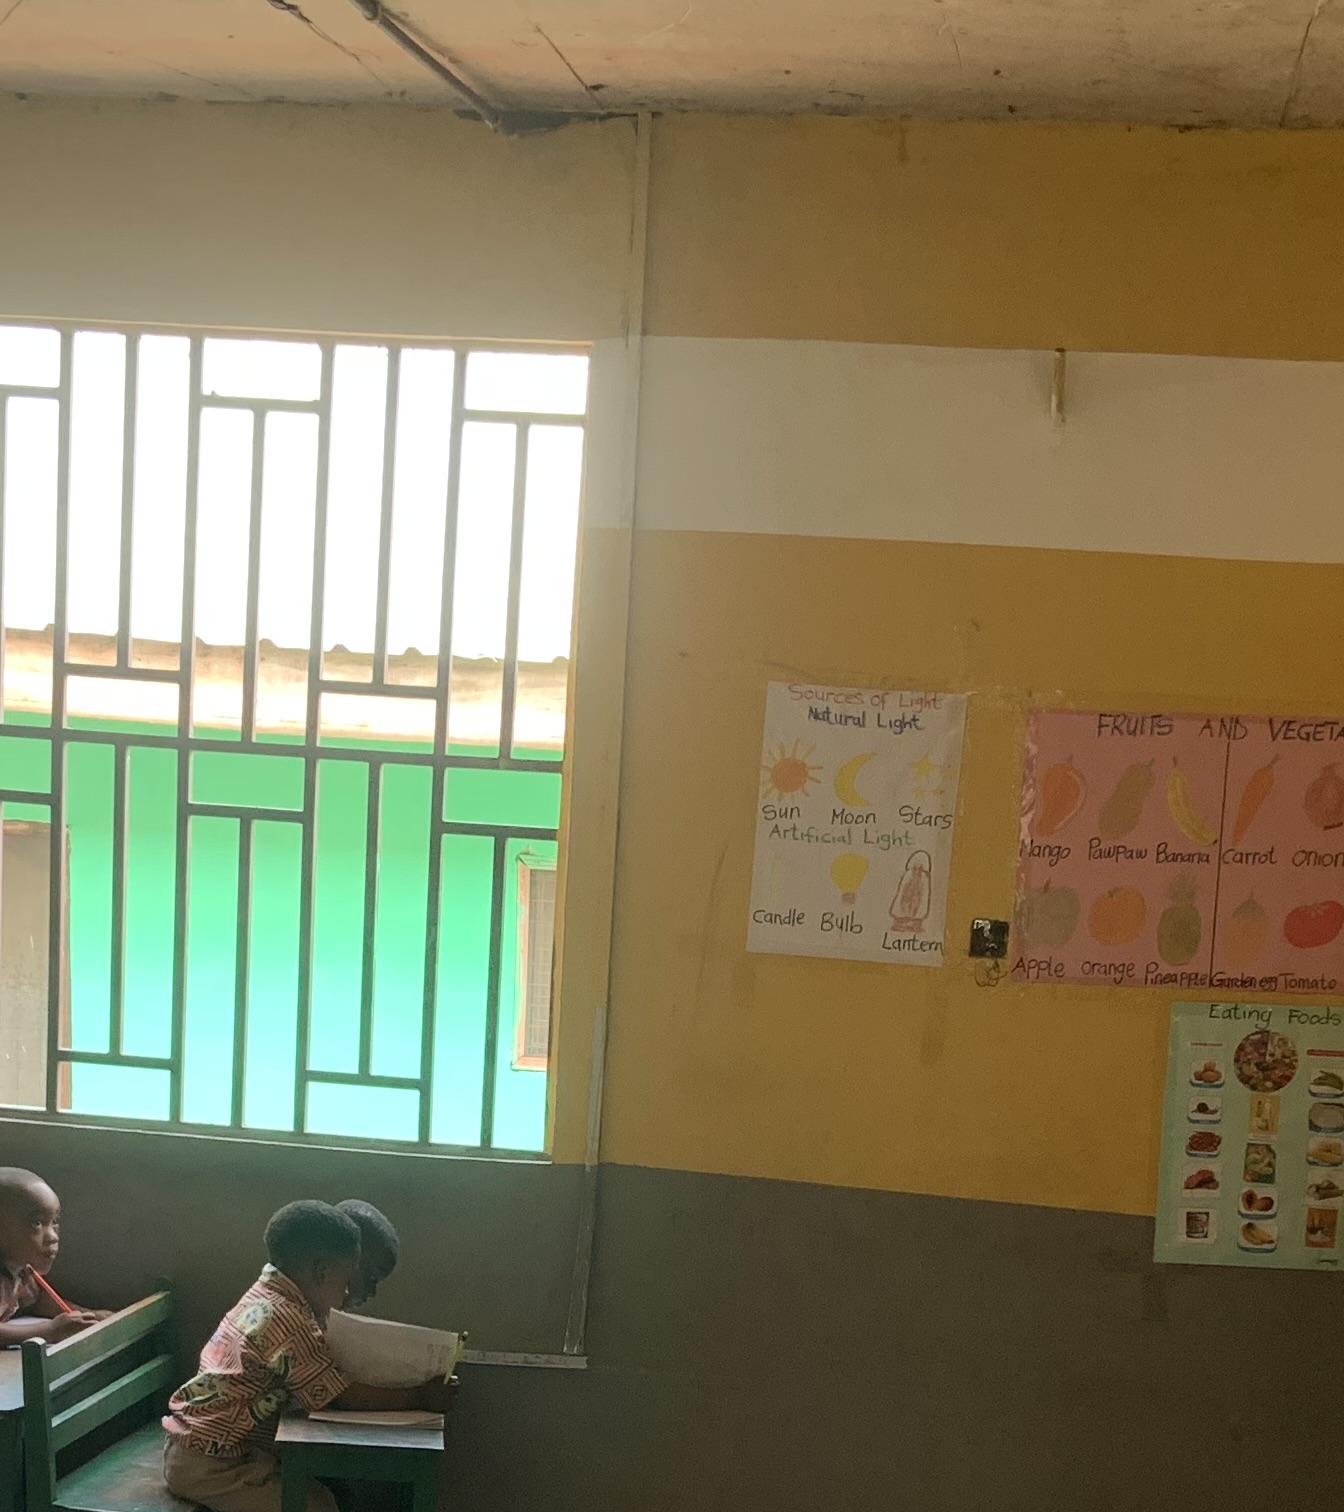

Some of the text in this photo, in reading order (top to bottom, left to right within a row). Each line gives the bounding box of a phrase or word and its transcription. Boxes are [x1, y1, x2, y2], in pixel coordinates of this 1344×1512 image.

[788, 683, 943, 712] Sources of Light
[808, 707, 926, 735] Natural Light
[1097, 714, 1174, 738] FRUITS
[1199, 718, 1248, 741] AND
[762, 804, 801, 821] Sun
[831, 808, 877, 826] Moon
[899, 805, 954, 829] Stars
[769, 823, 914, 851] Artificial Light
[1020, 838, 1071, 868] Mango
[1155, 842, 1210, 864] Banana
[753, 909, 805, 926] Candle
[820, 911, 863, 934] Bulb
[882, 932, 944, 957] Lantern
[1011, 957, 1065, 980] Apple
[1144, 962, 1208, 985] Pineapple
[1280, 972, 1336, 990] Tomato
[1208, 1003, 1342, 1030] Eating Foods
